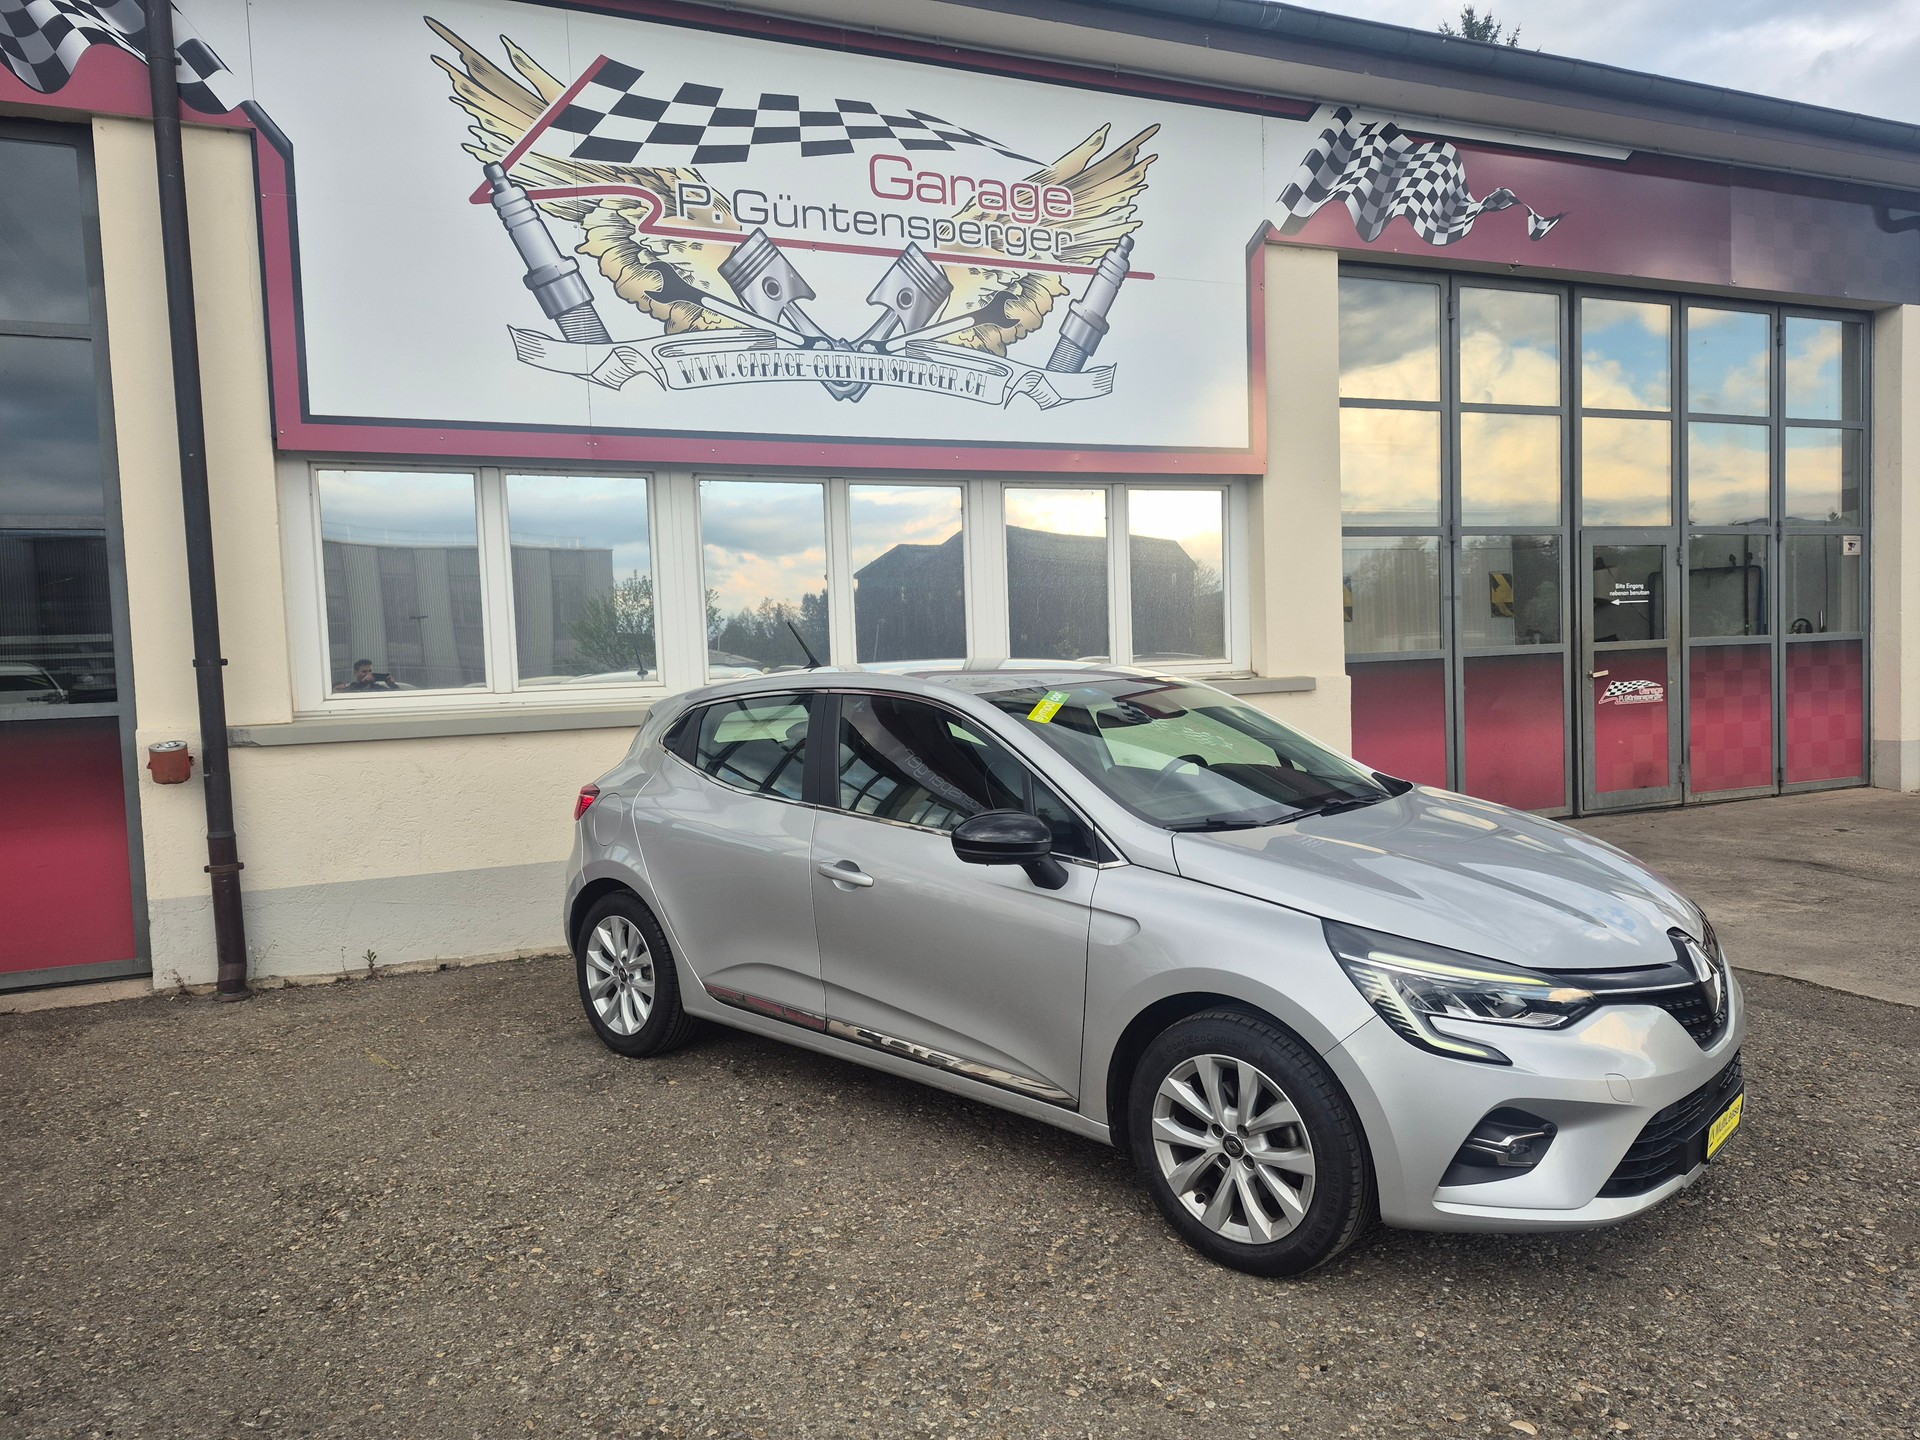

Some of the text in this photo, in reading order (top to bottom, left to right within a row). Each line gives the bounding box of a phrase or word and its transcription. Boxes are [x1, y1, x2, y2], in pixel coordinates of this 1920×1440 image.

[733, 189, 1073, 256] Güntensperger
[869, 154, 1072, 224] Garage
[677, 353, 988, 398] WWW.GARAGE-GUENTENSPERGER.CH
